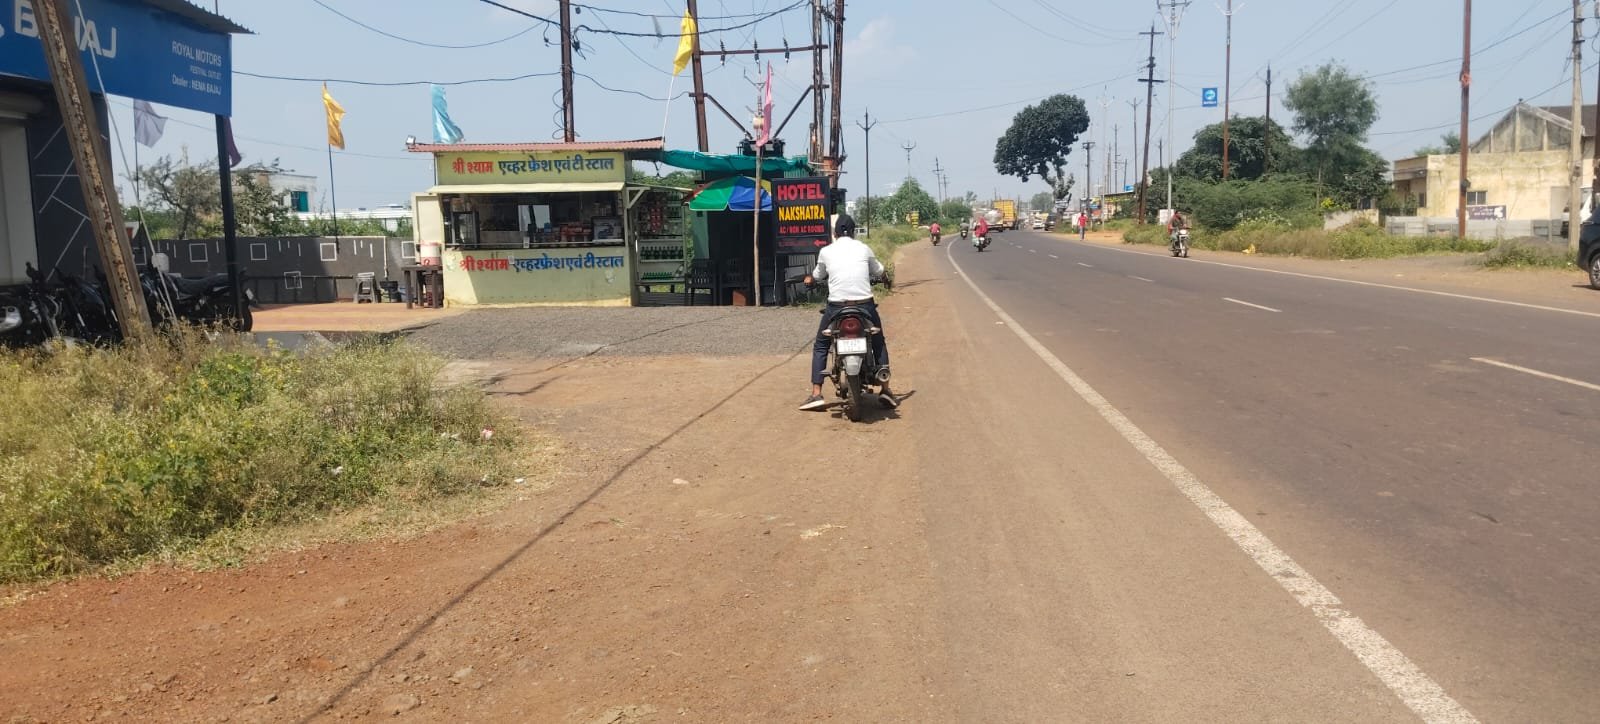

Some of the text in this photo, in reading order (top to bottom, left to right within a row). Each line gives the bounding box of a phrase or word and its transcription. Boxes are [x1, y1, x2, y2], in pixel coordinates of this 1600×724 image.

[172, 40, 222, 67] ROYAL MOTORS
[452, 157, 465, 175] श्री
[467, 161, 494, 175] श्याम
[777, 183, 825, 201] HOTEL
[778, 205, 825, 221] NAKSHATRA
[459, 255, 476, 272] श्री
[477, 258, 509, 272] श्याम
